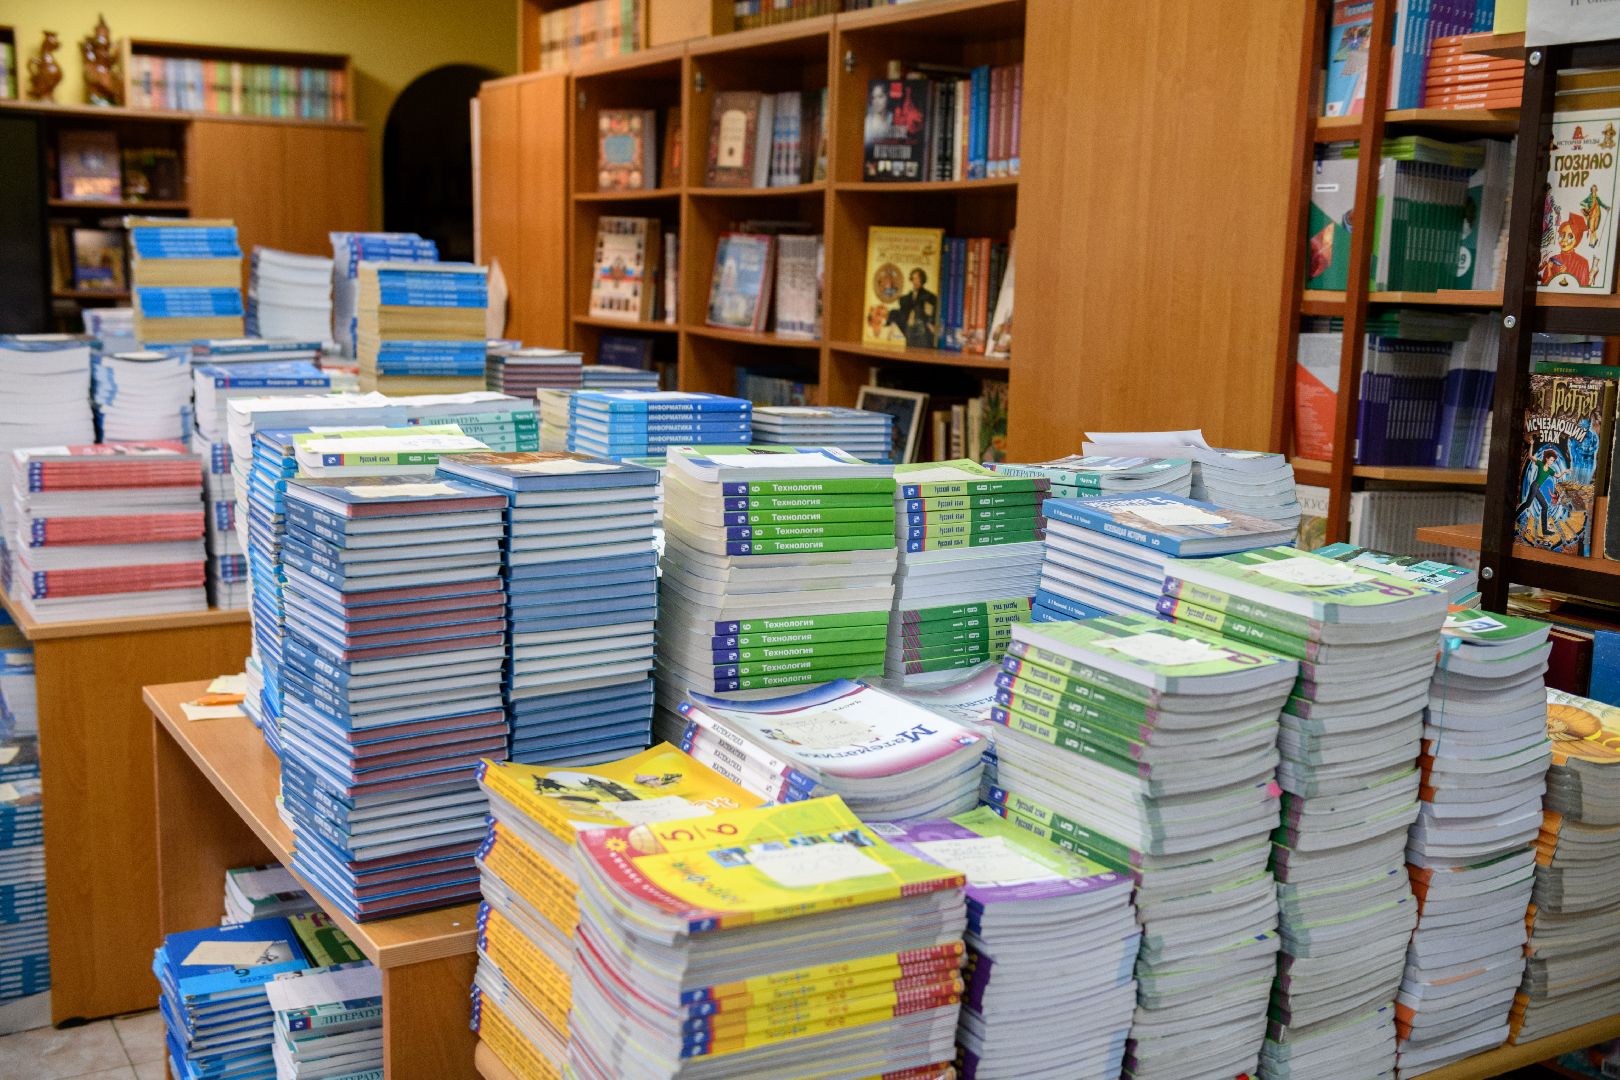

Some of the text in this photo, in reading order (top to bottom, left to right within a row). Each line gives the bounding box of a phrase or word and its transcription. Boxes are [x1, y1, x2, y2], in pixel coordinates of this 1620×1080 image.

[1554, 152, 1612, 171] ПОЗНАЮ
[1558, 170, 1590, 188] МИР
[1550, 378, 1598, 421] Гроттер
[1526, 418, 1587, 442] ИСЧЕЗАЮЩИЙ
[1540, 430, 1560, 444] ЭТАЖ
[773, 484, 822, 492] Технология
[772, 498, 820, 506] Технология
[772, 513, 820, 522] Технология
[776, 526, 824, 535] Технология
[774, 542, 824, 550] Технология
[764, 620, 814, 629] Технология
[762, 634, 812, 643] Технология
[764, 648, 814, 657] Технология
[762, 662, 811, 672] Технология
[763, 674, 812, 684] Технология
[796, 724, 938, 758] Математика
[714, 750, 742, 773] МАТЕМАТИКА
[1060, 821, 1074, 832] 5
[1060, 839, 1072, 850] 5
[322, 1008, 382, 1026] ЛИТЕРАТУР
